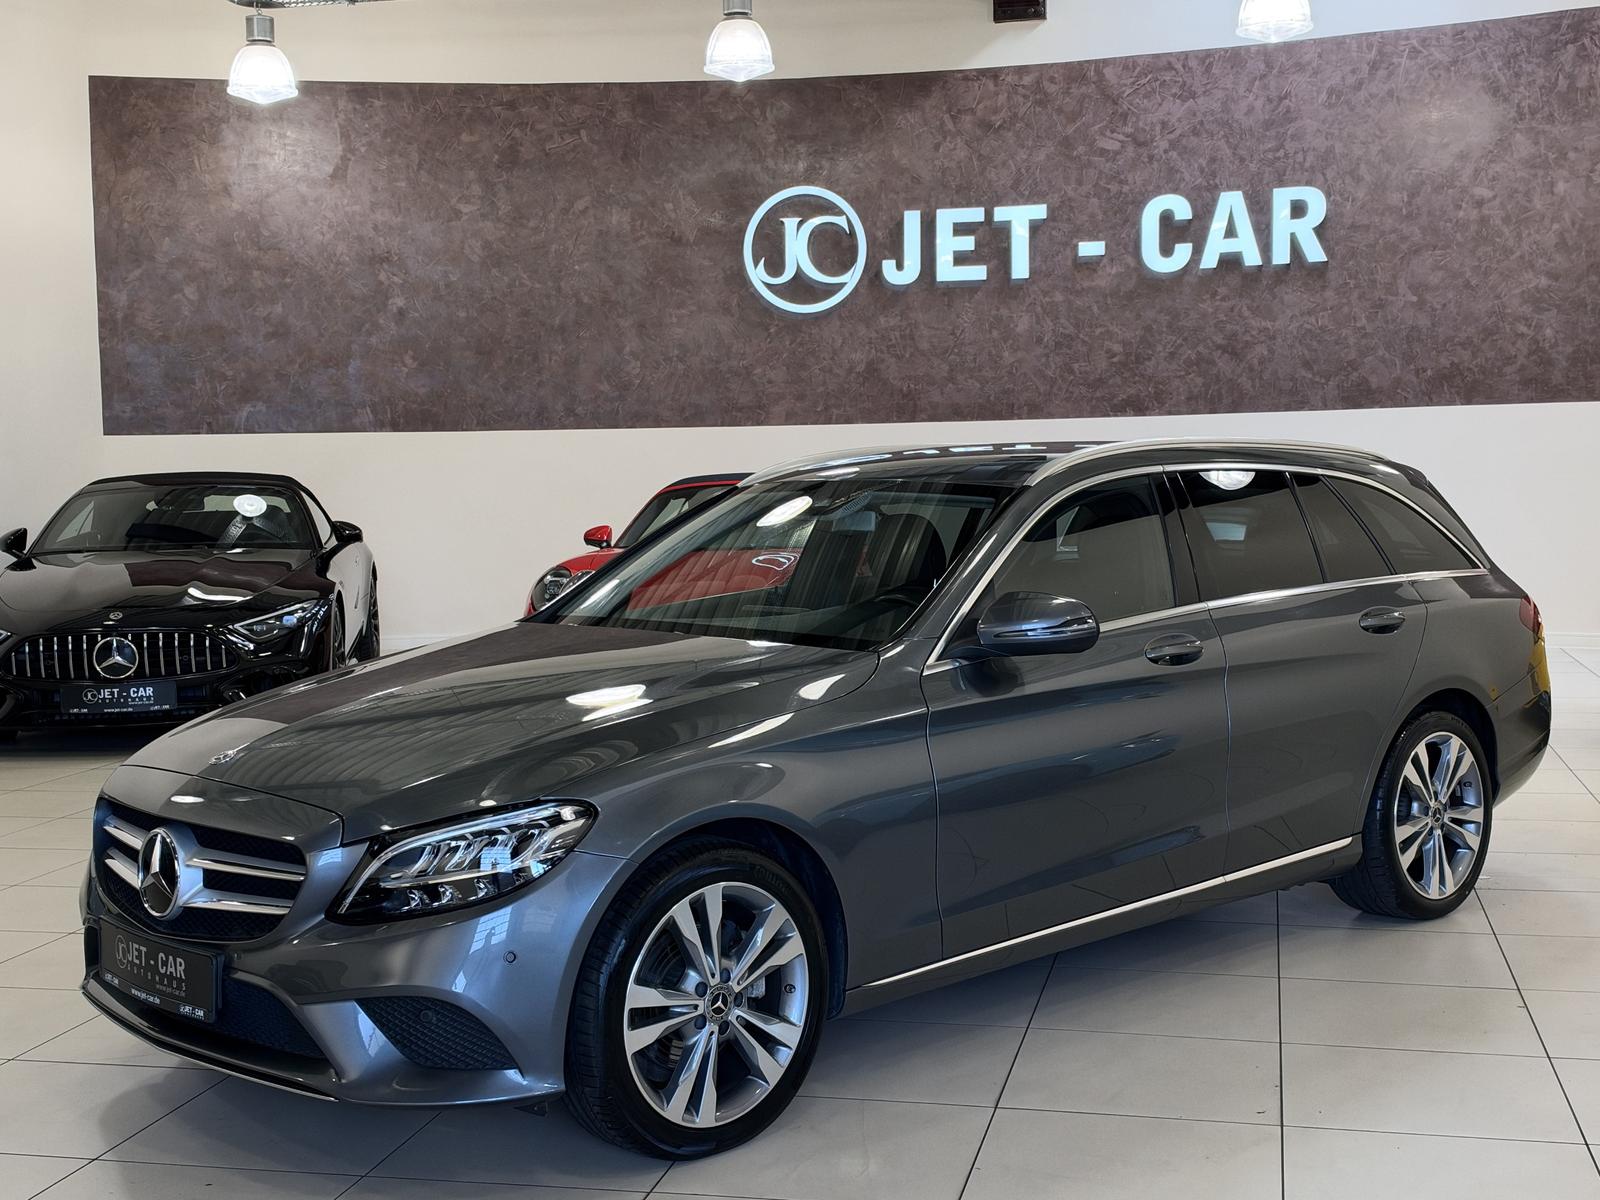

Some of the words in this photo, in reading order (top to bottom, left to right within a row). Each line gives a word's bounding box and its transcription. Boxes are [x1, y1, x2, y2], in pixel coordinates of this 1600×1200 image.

[881, 203, 1048, 286] JET
[1140, 185, 1329, 274] CAR
[98, 688, 120, 699] JET
[130, 686, 154, 698] CAR
[127, 941, 147, 967] JET
[158, 952, 185, 980] CAR
